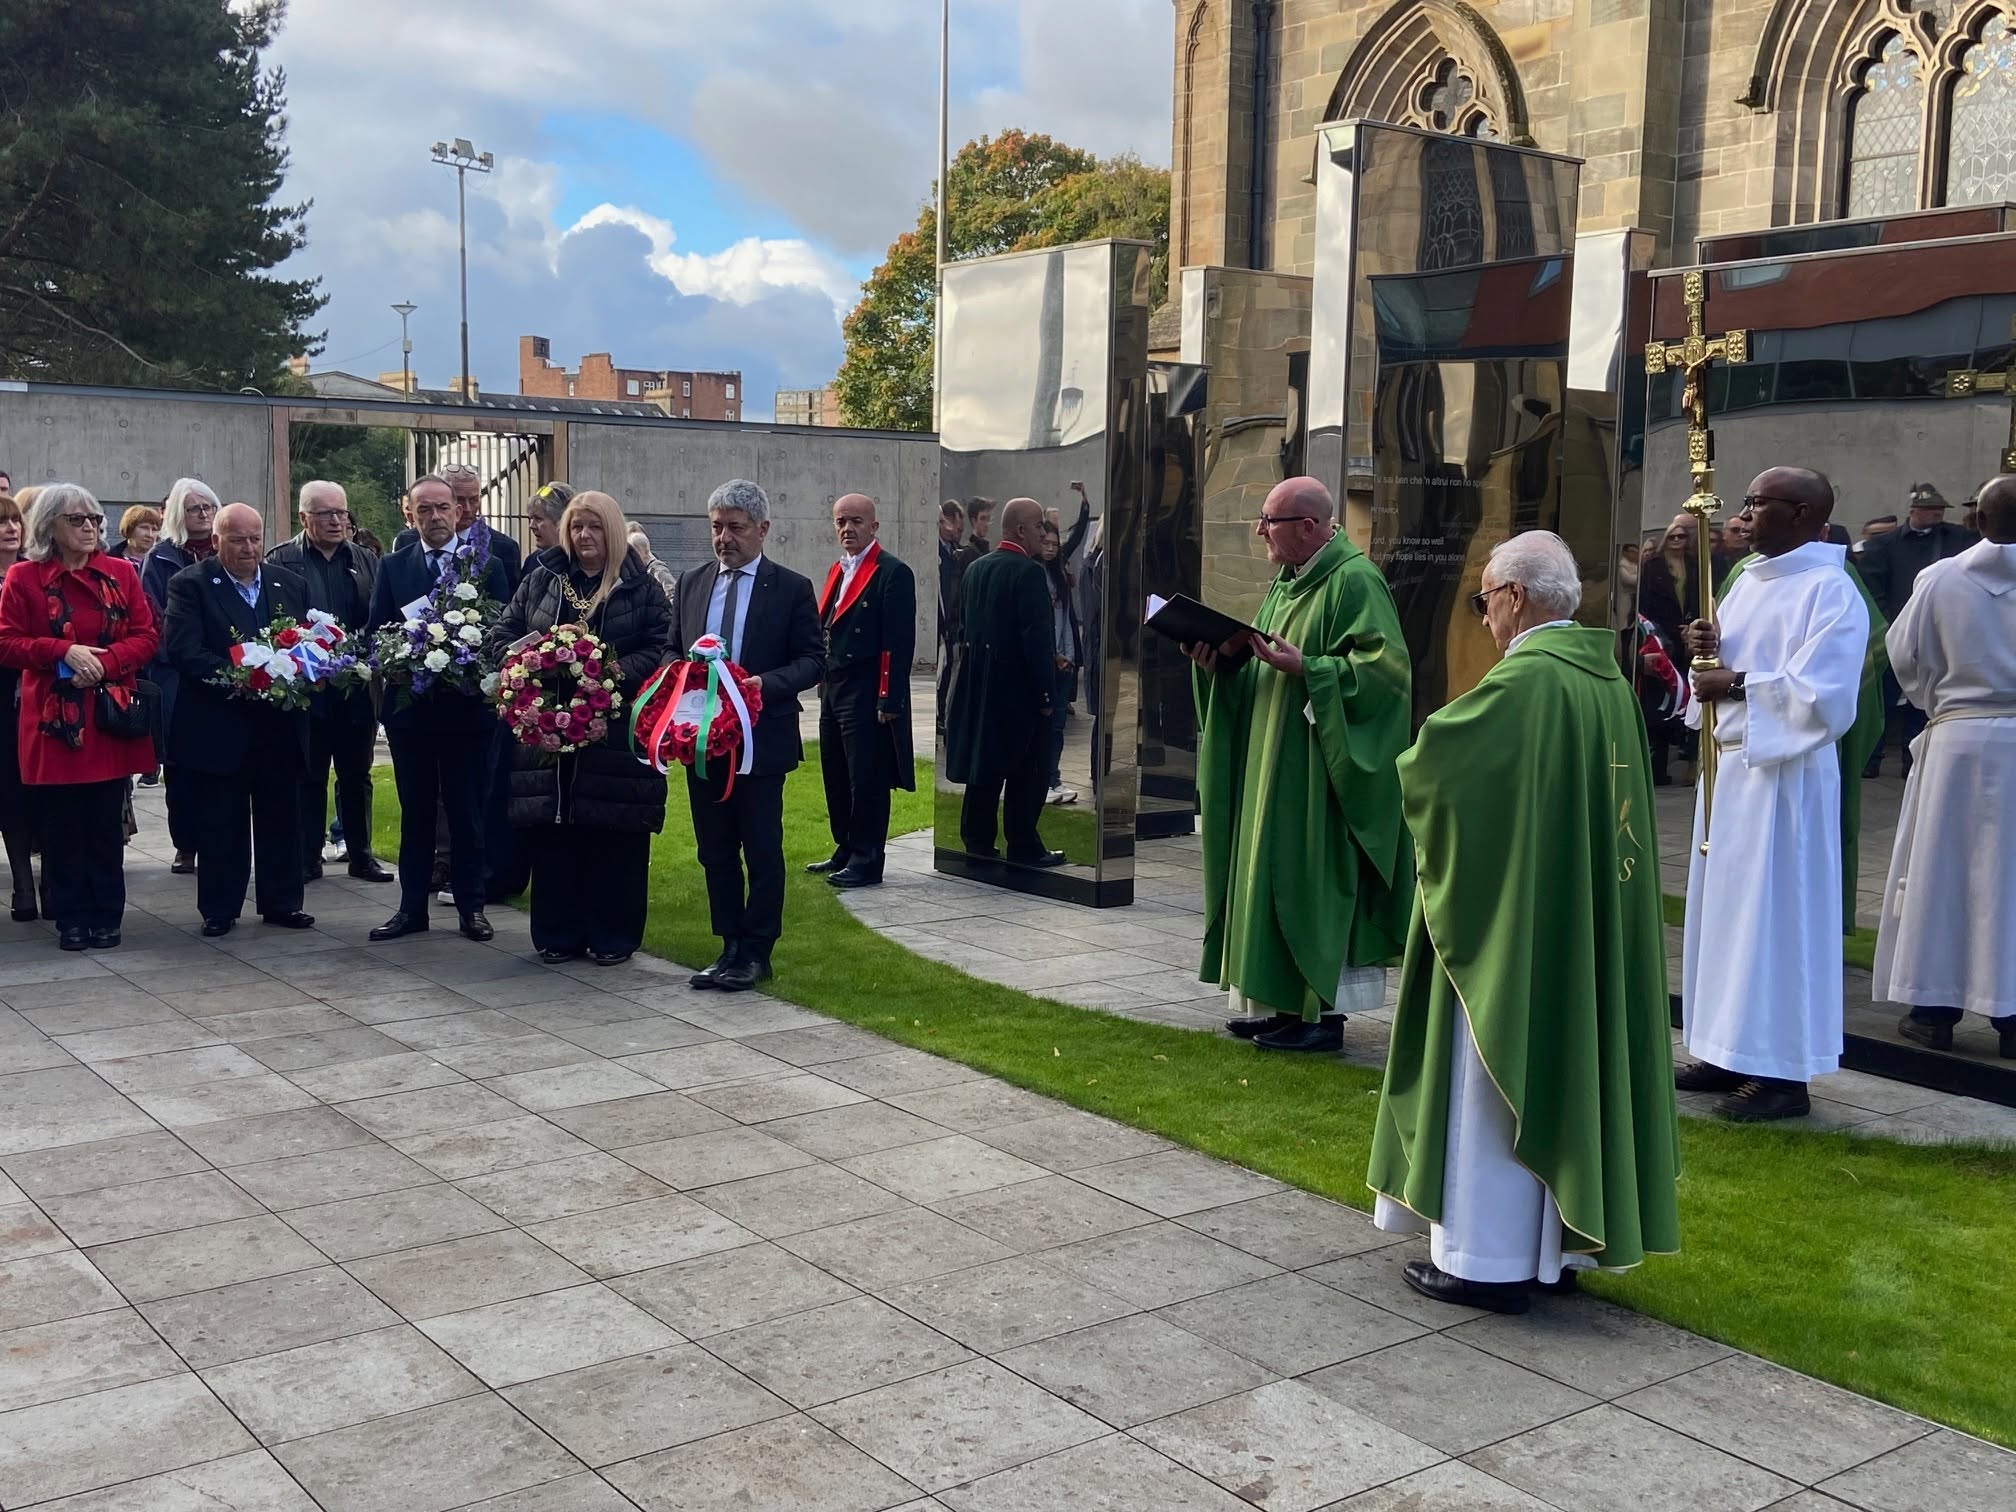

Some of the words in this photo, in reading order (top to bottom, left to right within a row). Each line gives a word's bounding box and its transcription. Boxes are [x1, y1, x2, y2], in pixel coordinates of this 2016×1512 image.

[1388, 537, 1401, 547] you
[1402, 536, 1421, 545] know
[1421, 537, 1430, 545] so
[1431, 536, 1444, 545] well
[1396, 551, 1413, 562] hope
[1414, 552, 1426, 561] lies
[1427, 552, 1434, 561] in
[1435, 554, 1447, 563] you
